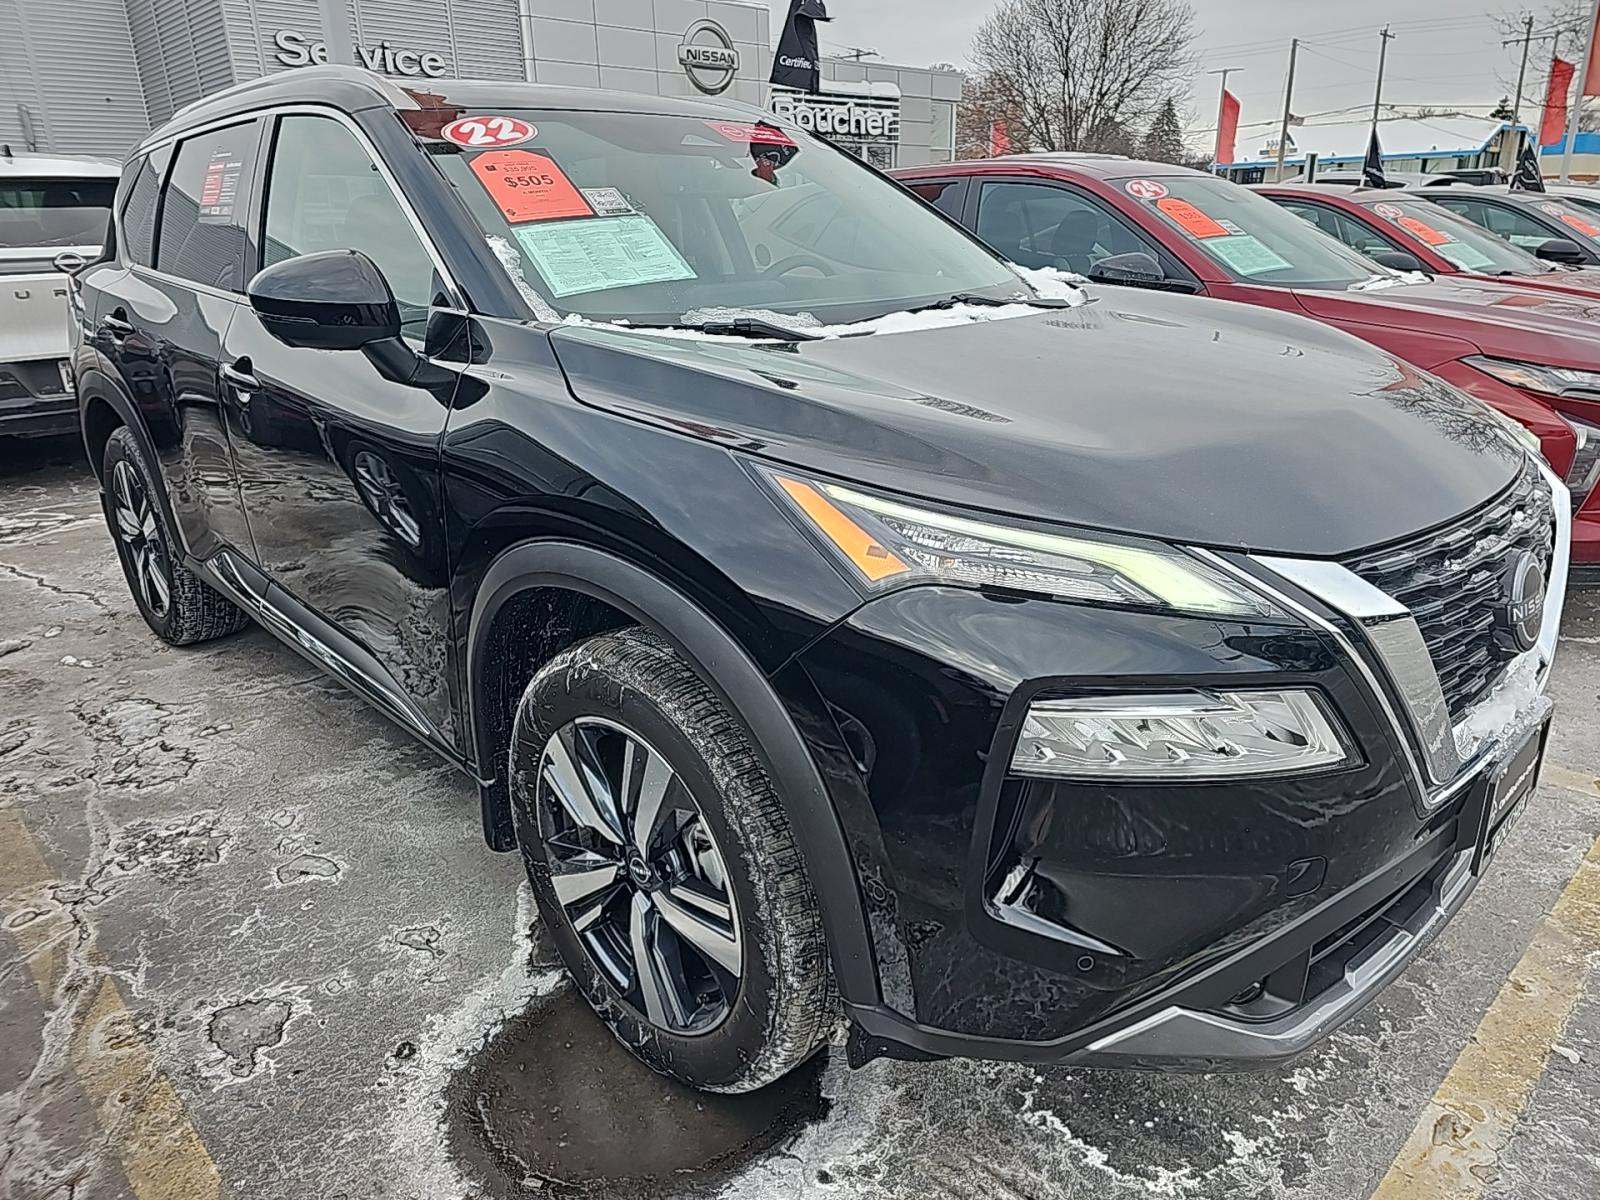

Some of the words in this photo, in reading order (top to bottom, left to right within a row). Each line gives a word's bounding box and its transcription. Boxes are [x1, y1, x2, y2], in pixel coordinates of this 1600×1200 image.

[275, 29, 446, 78] Sevice
[685, 48, 736, 66] NISSAN
[772, 97, 895, 137] Boucher
[458, 118, 525, 145] 22
[504, 174, 554, 188] $505
[1512, 594, 1543, 621] NISS
